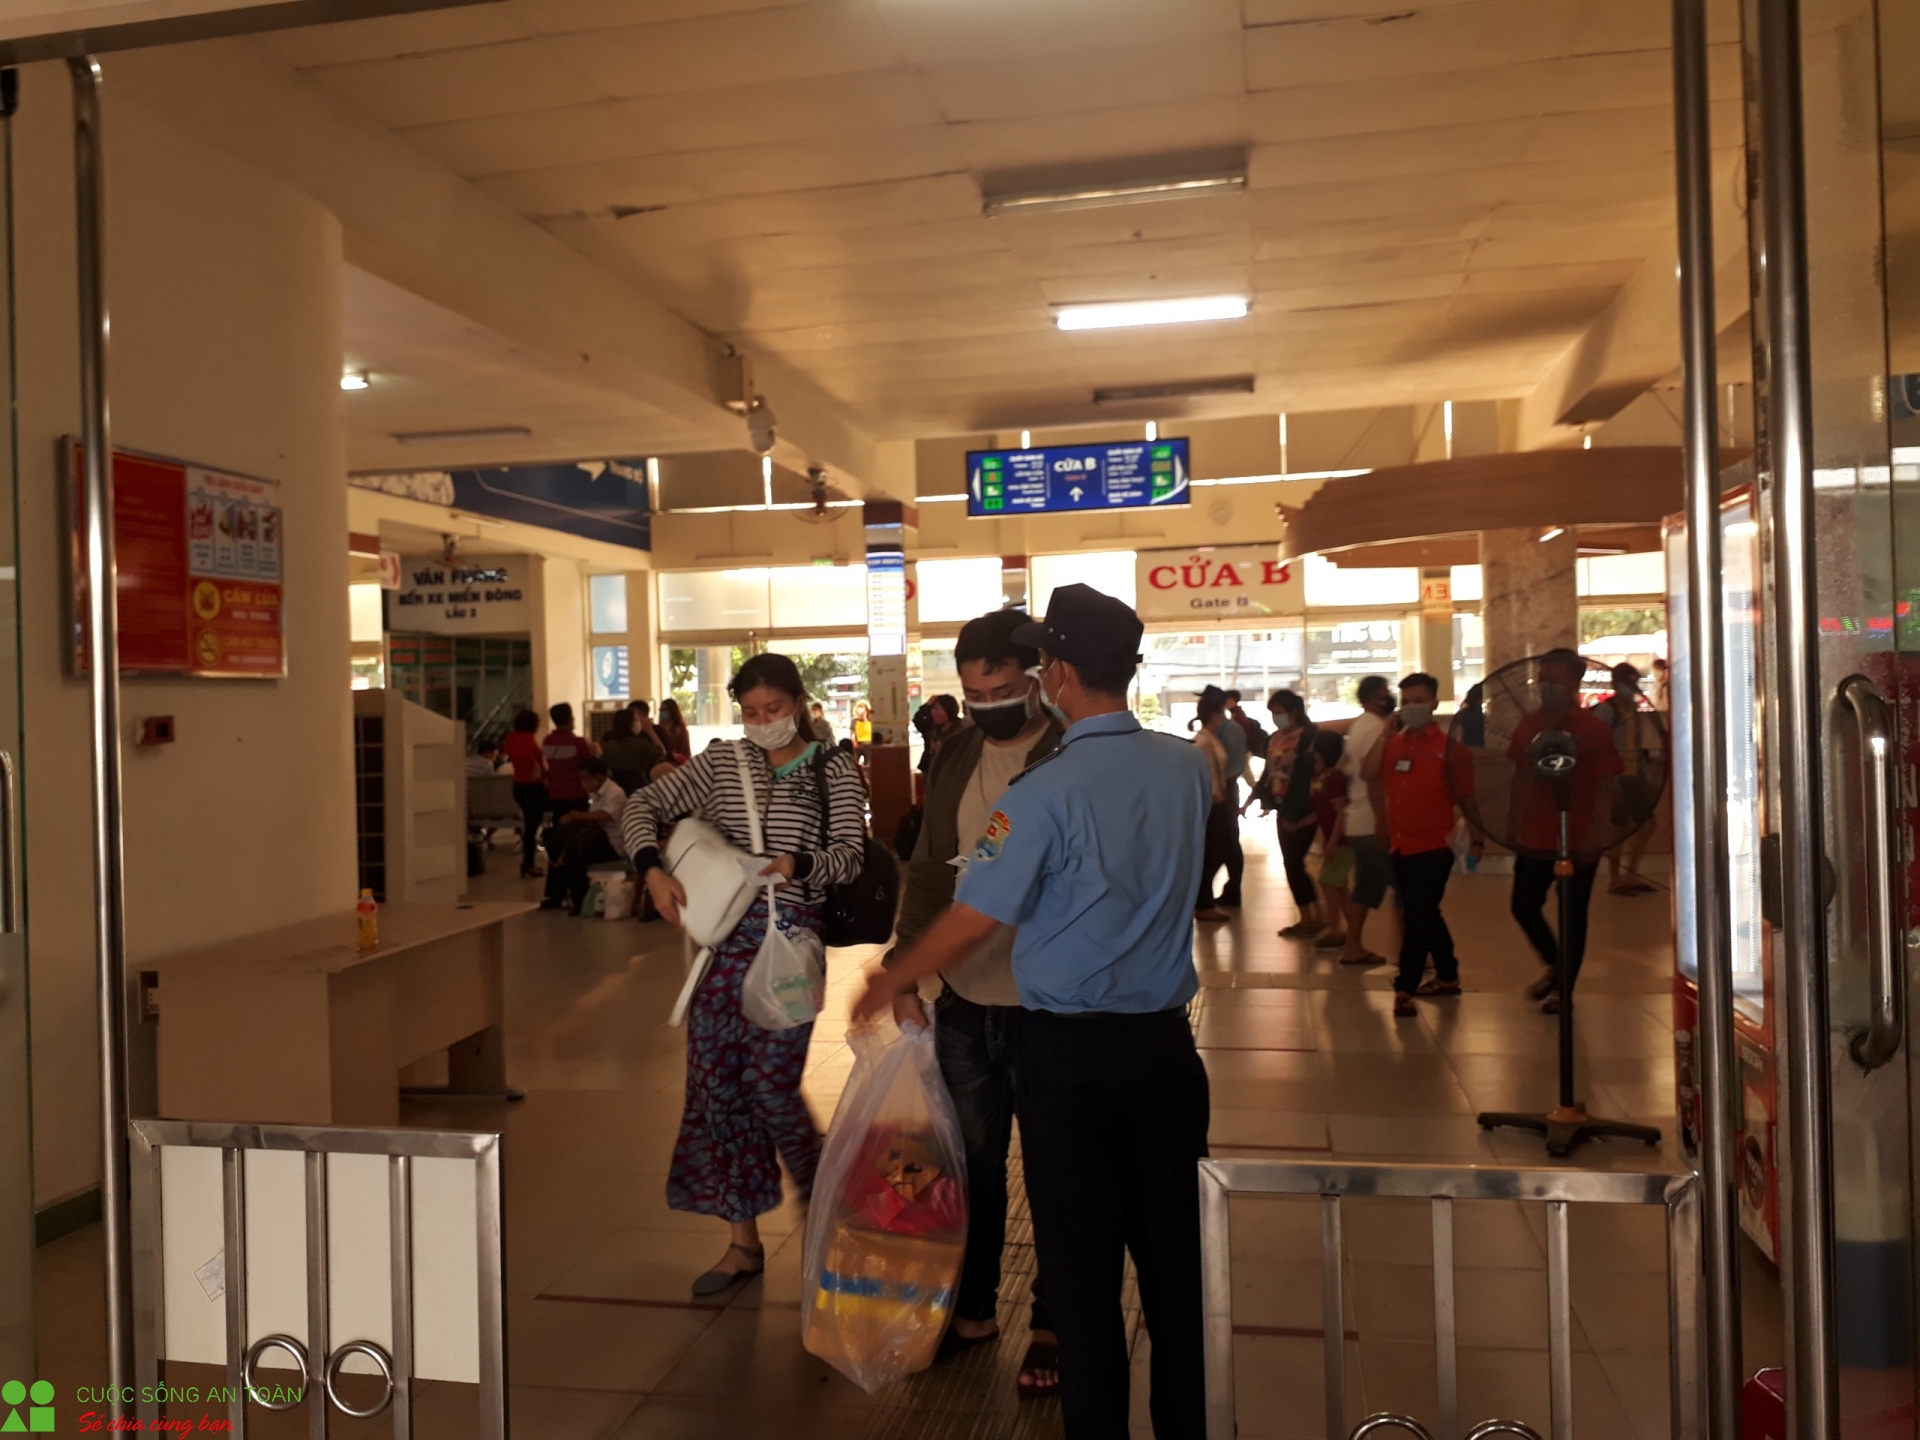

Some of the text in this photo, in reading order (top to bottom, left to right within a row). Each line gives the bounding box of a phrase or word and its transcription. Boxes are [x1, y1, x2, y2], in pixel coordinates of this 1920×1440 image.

[1053, 457, 1083, 472] CỬA
[1084, 456, 1097, 471] B
[413, 567, 444, 586] VĂN
[1148, 555, 1291, 590] CỬA B
[428, 592, 444, 604] XE
[485, 587, 522, 602] ĐÔNG
[1190, 597, 1230, 609] Gate
